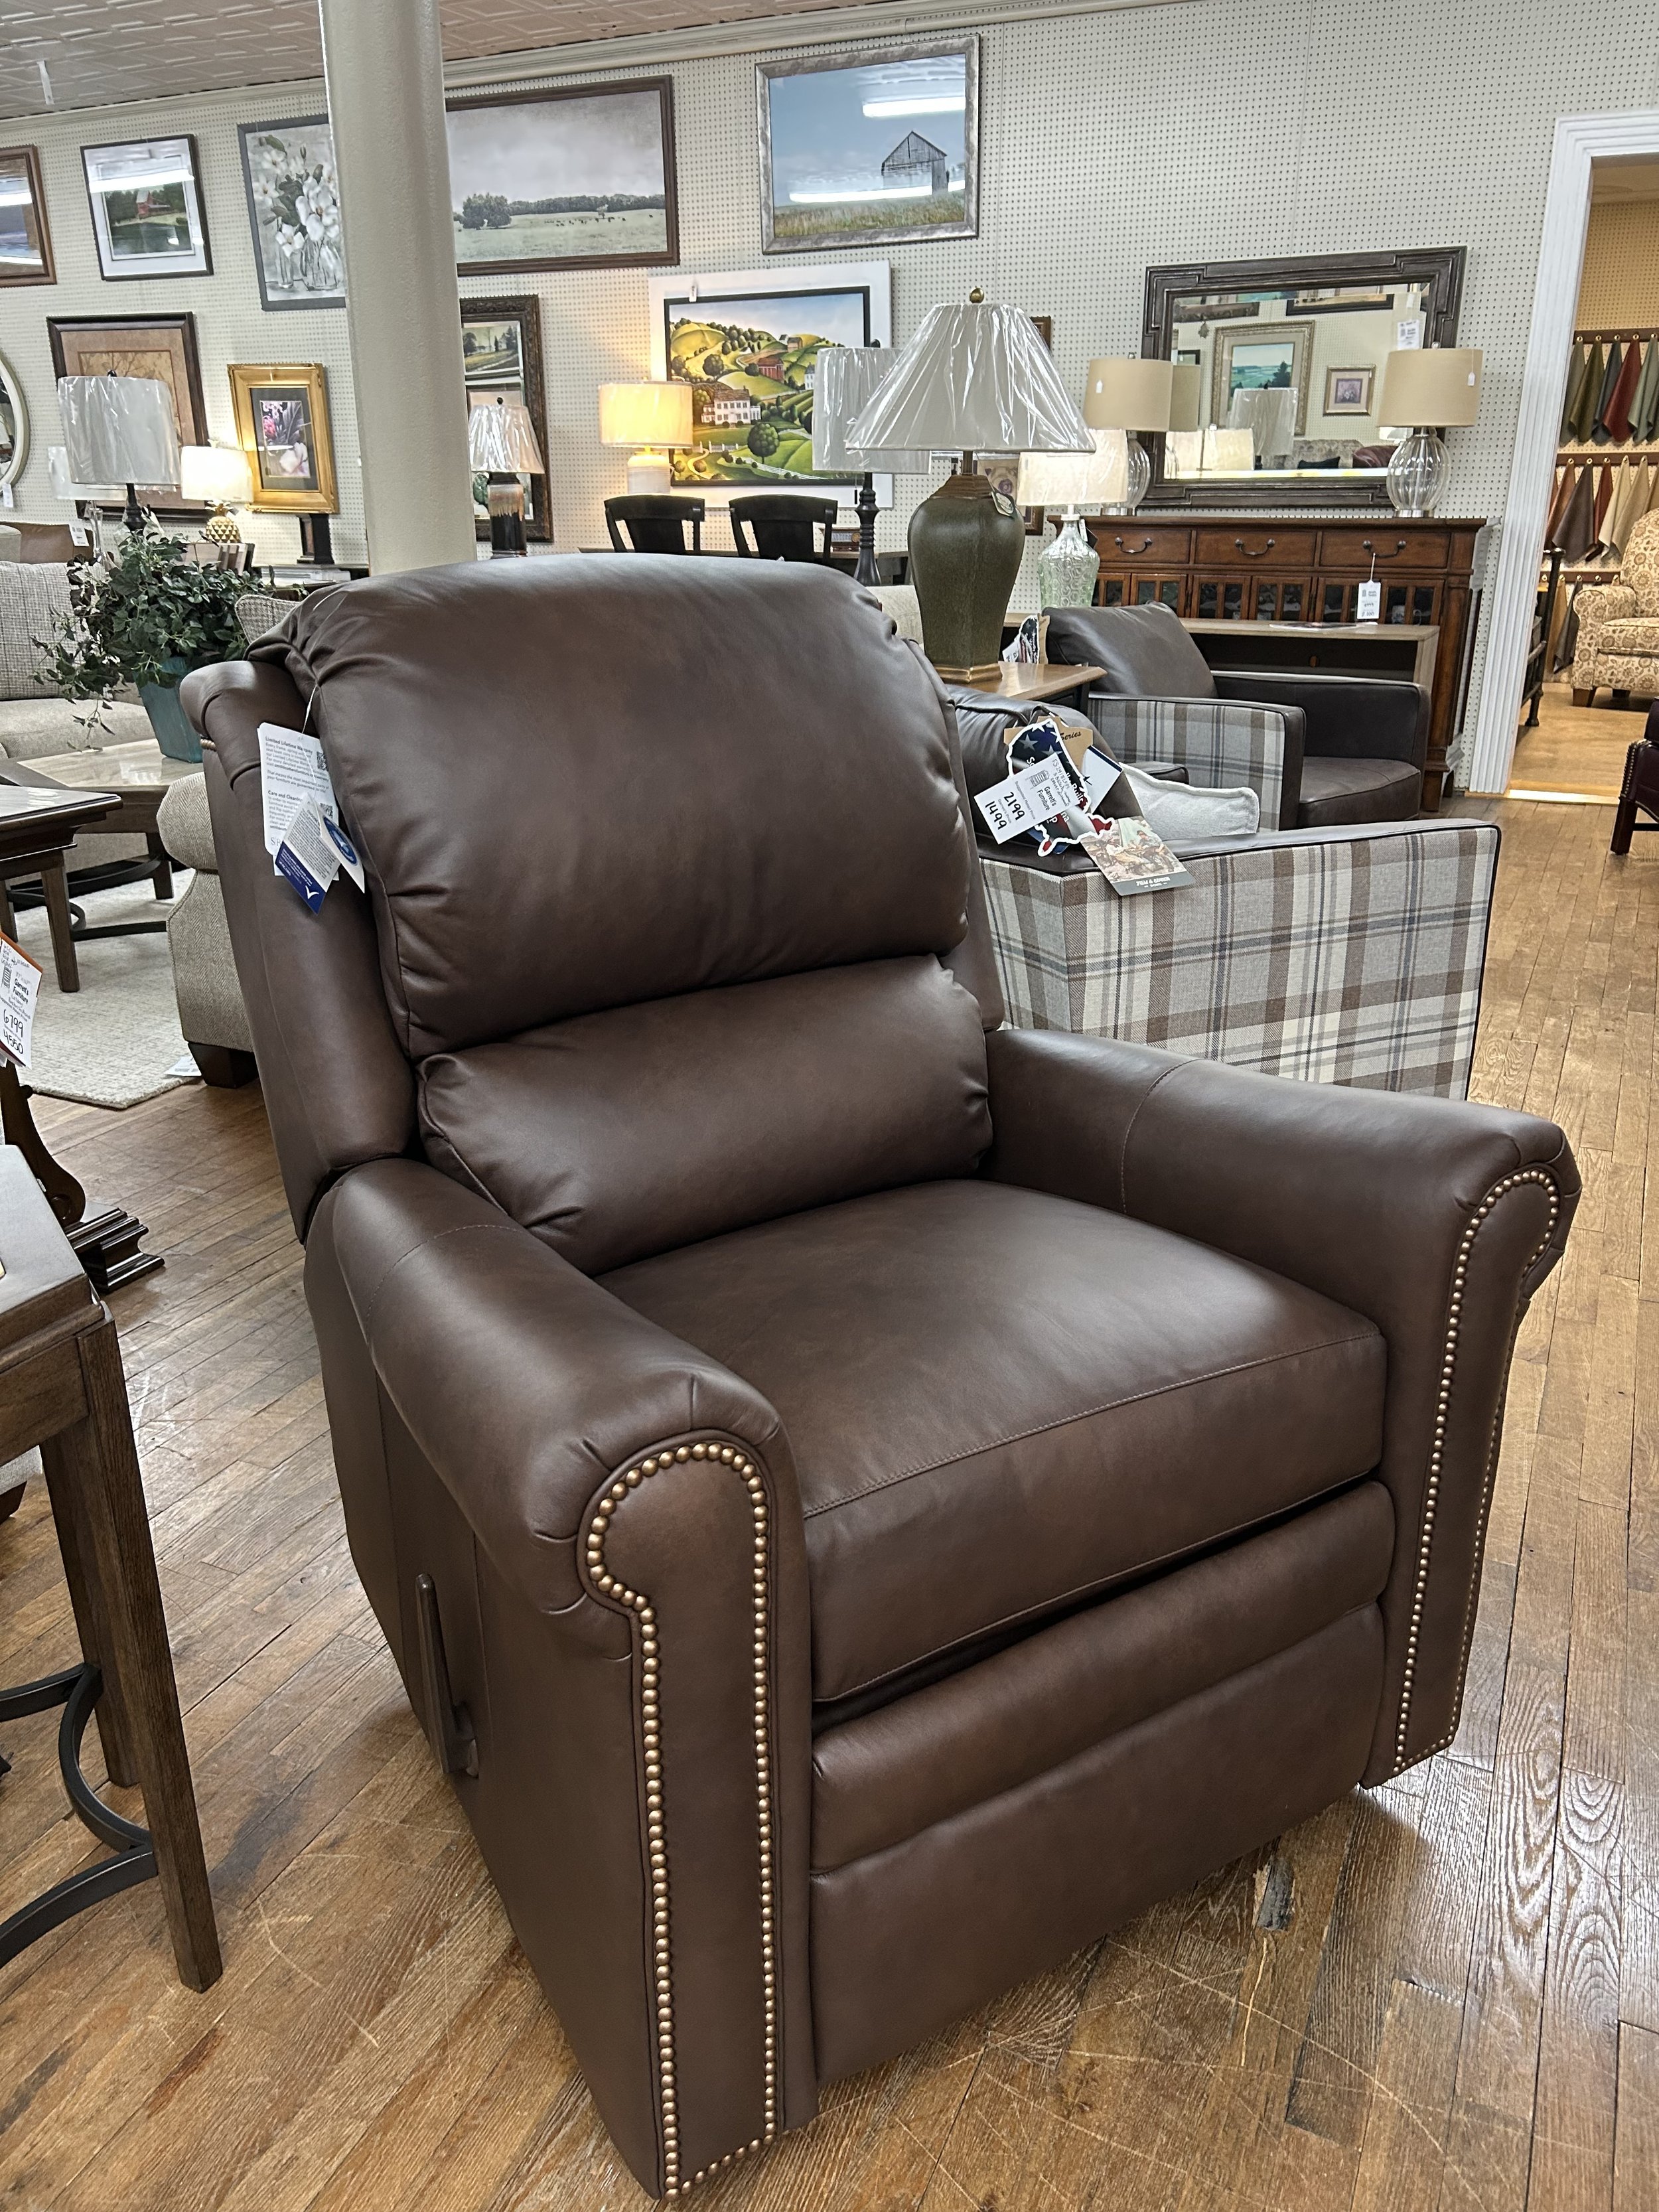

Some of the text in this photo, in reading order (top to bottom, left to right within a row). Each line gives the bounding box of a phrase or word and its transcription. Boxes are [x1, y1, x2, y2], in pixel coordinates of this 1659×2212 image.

[1003, 790, 1026, 820] 2199
[1036, 789, 1052, 811] Furniture
[1043, 786, 1058, 806] Garrett's
[985, 800, 1008, 830] 1499
[13, 986, 28, 1004] Furniture
[15, 978, 29, 995] Garrett's
[4, 1009, 23, 1038] 6799
[4, 1029, 23, 1053] 4550
